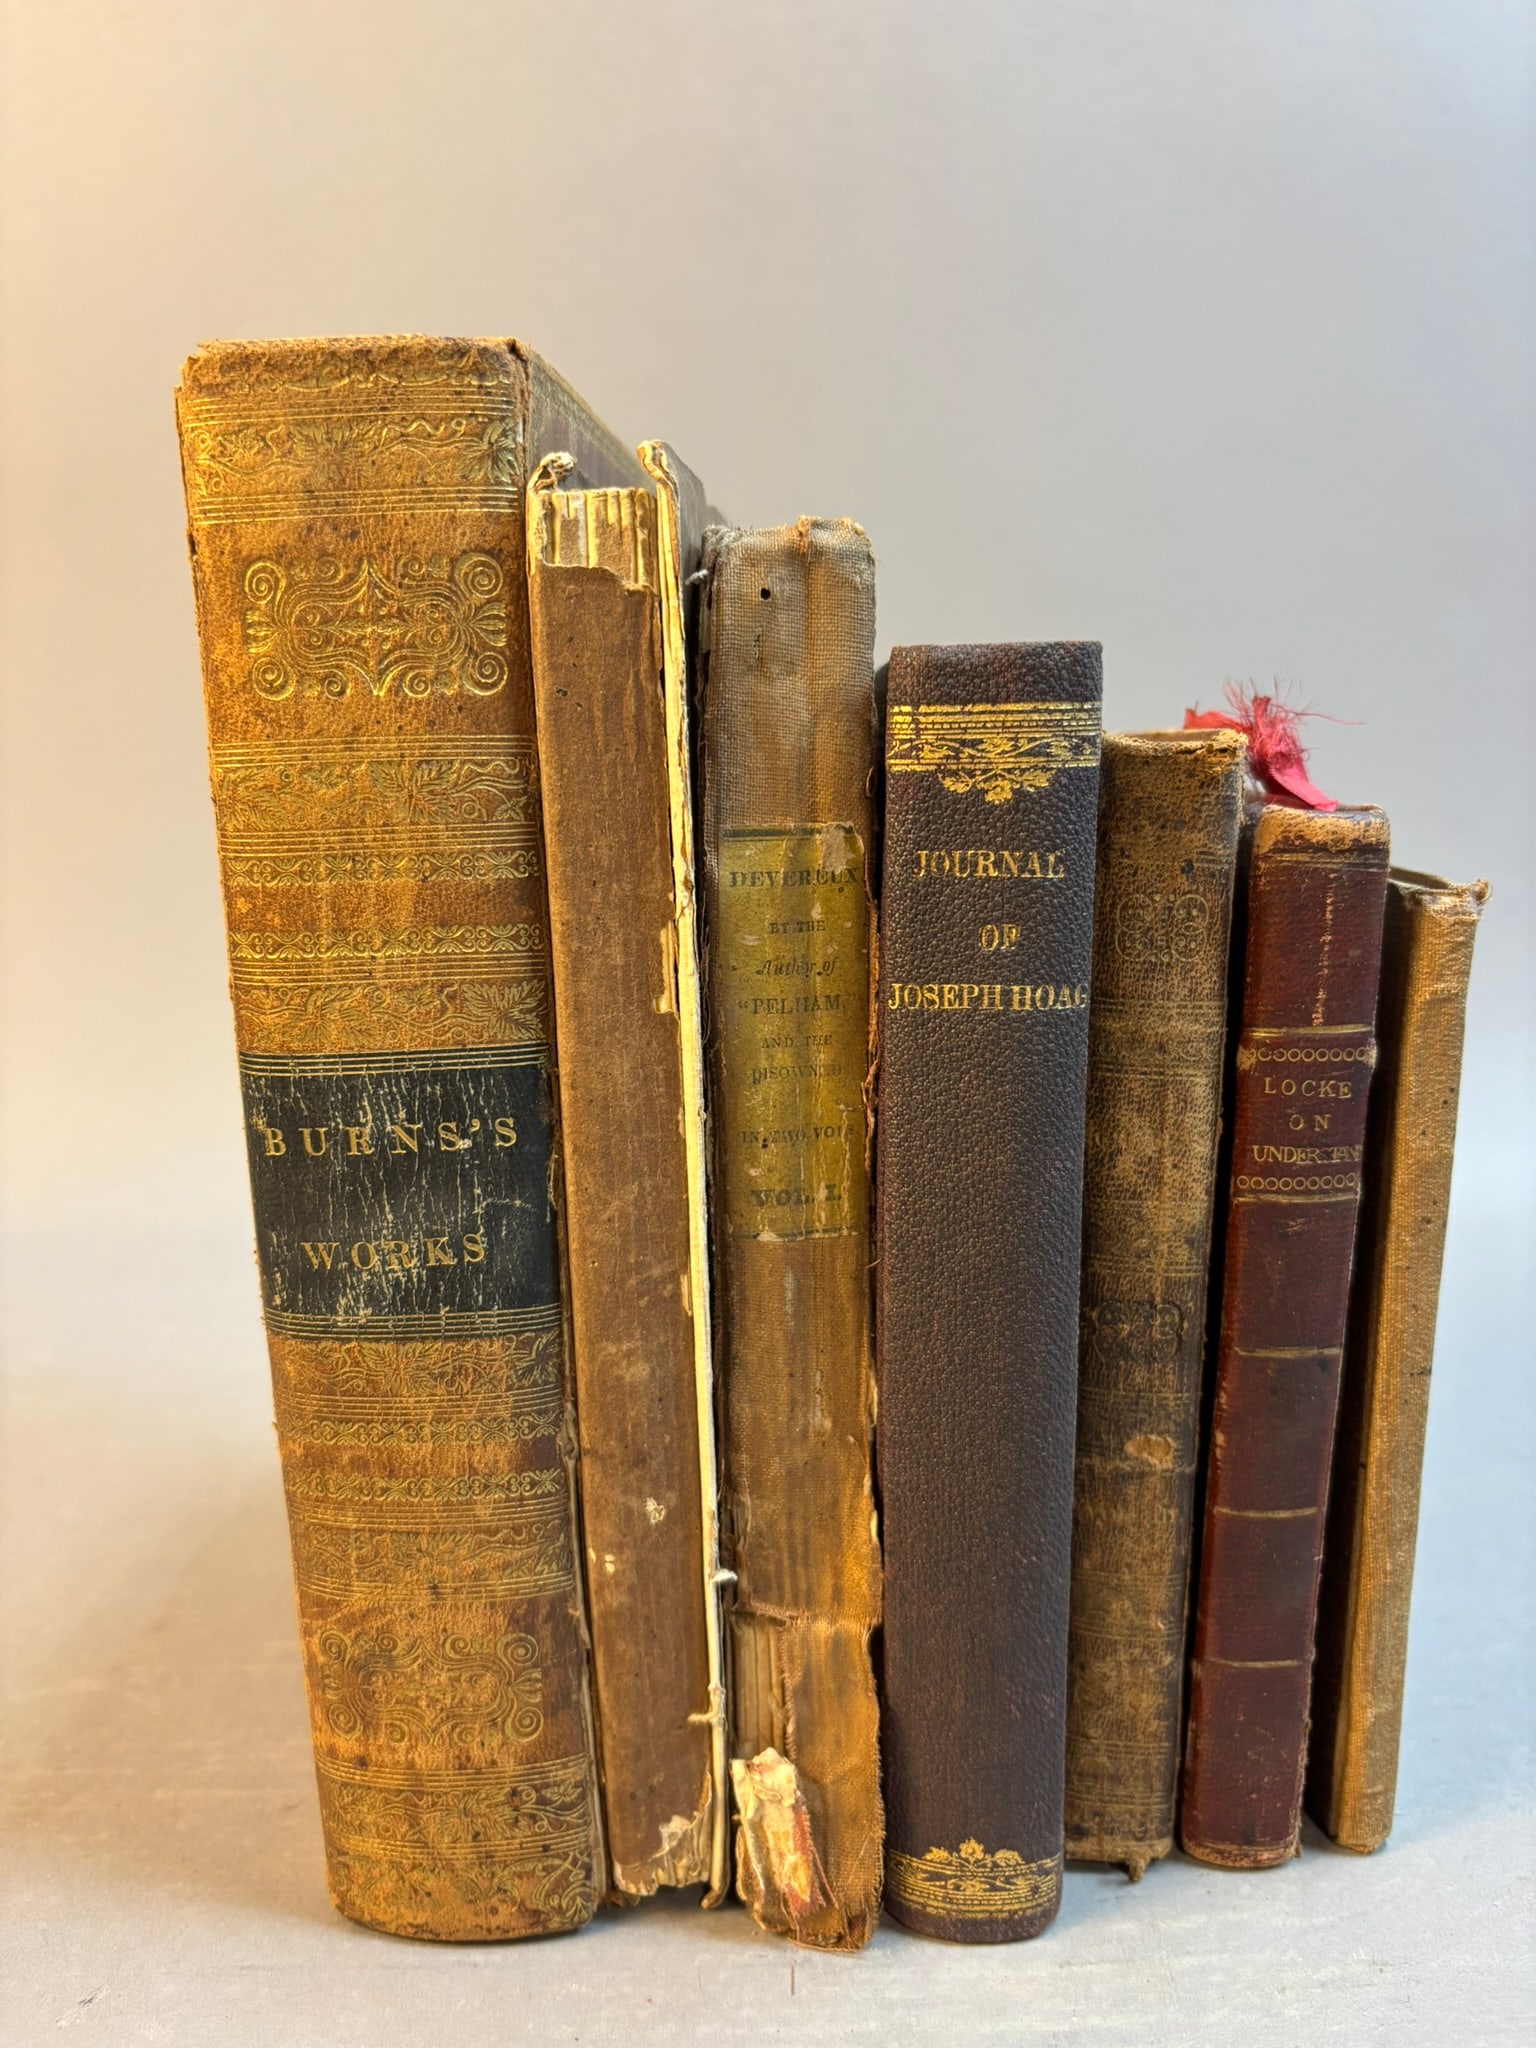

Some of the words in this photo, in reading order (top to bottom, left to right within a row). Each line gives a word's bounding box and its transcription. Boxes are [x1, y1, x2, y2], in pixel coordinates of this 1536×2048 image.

[912, 850, 1065, 878] JOURNAL
[768, 922, 789, 934] BY
[796, 920, 826, 933] THE
[978, 924, 1020, 951] OF
[888, 982, 1003, 1010] JOSEPH
[1010, 983, 1089, 1010] HOAG
[761, 1037, 793, 1049] AND
[805, 1034, 833, 1047] THE
[1264, 1077, 1352, 1098] LOCKE
[1289, 1114, 1330, 1131] ON
[300, 1232, 485, 1271] WORKS
